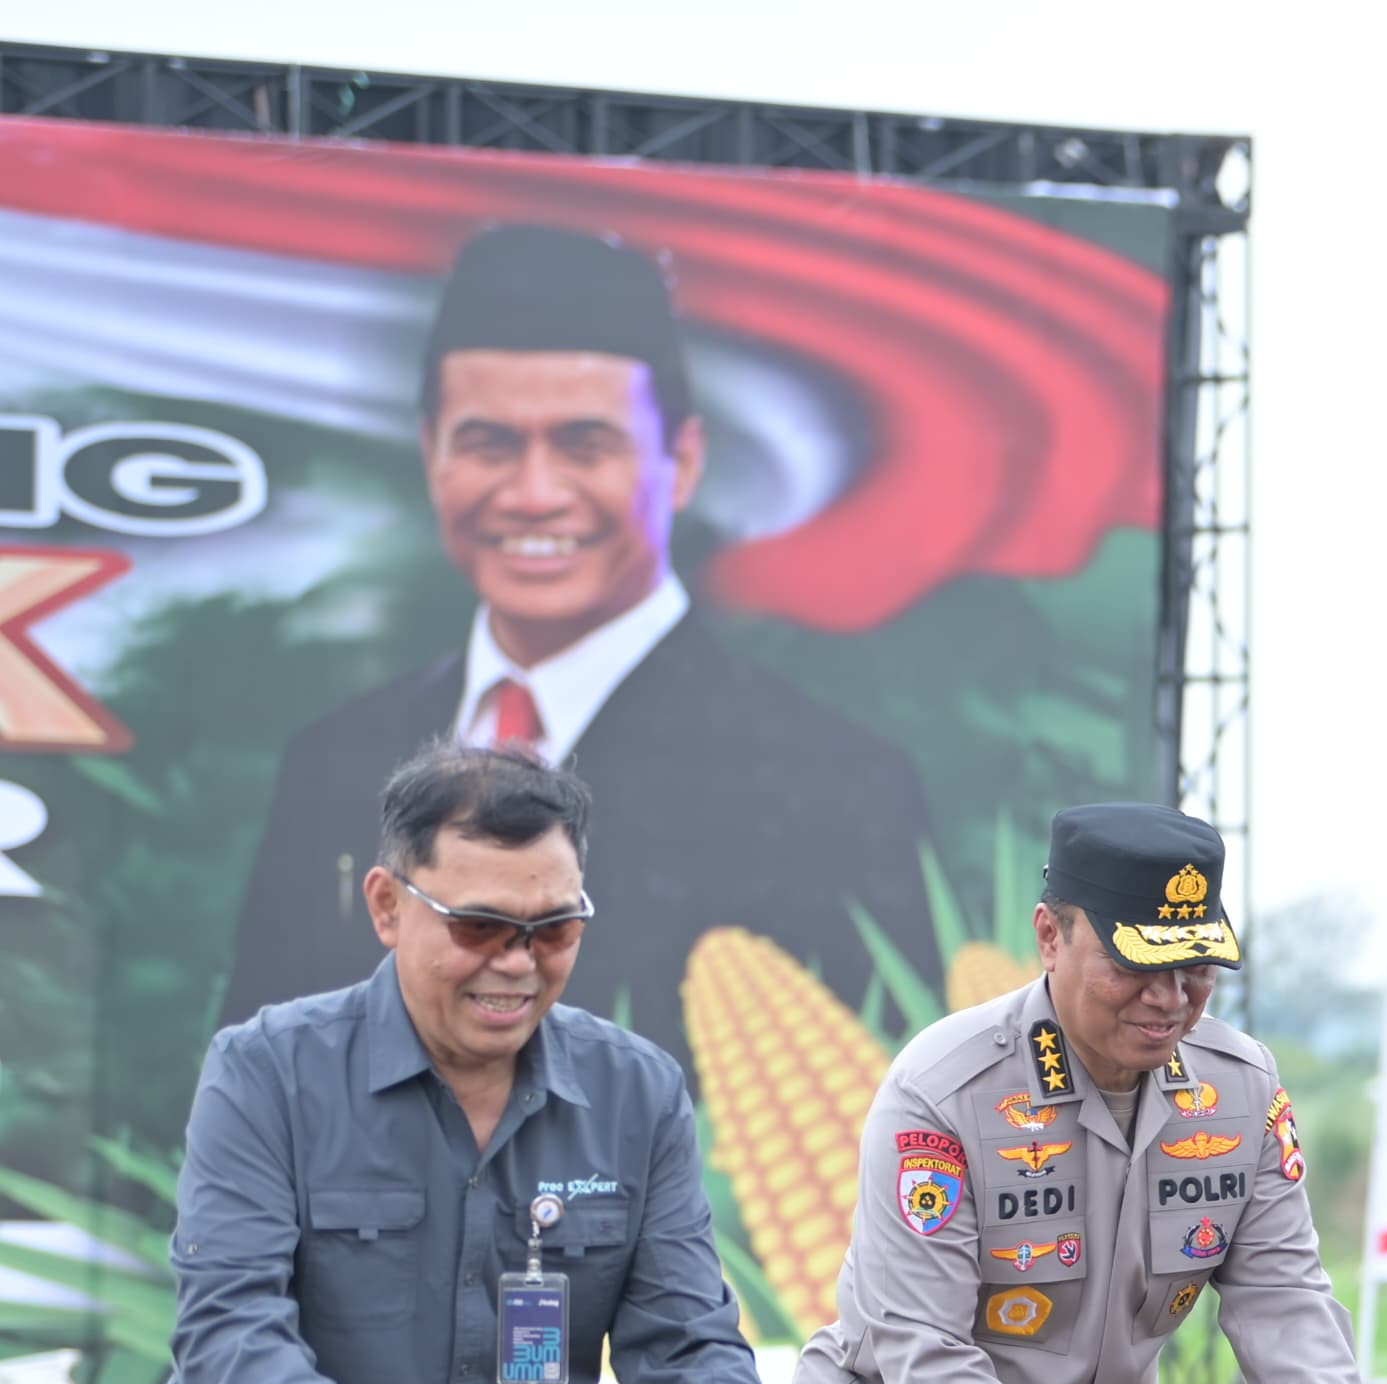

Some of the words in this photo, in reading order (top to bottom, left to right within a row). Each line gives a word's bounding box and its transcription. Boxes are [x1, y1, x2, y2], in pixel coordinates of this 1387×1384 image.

[903, 1157, 962, 1176] INSPEKTORAT
[998, 1184, 1075, 1220] DEDI
[1158, 1171, 1246, 1206] POLRI
